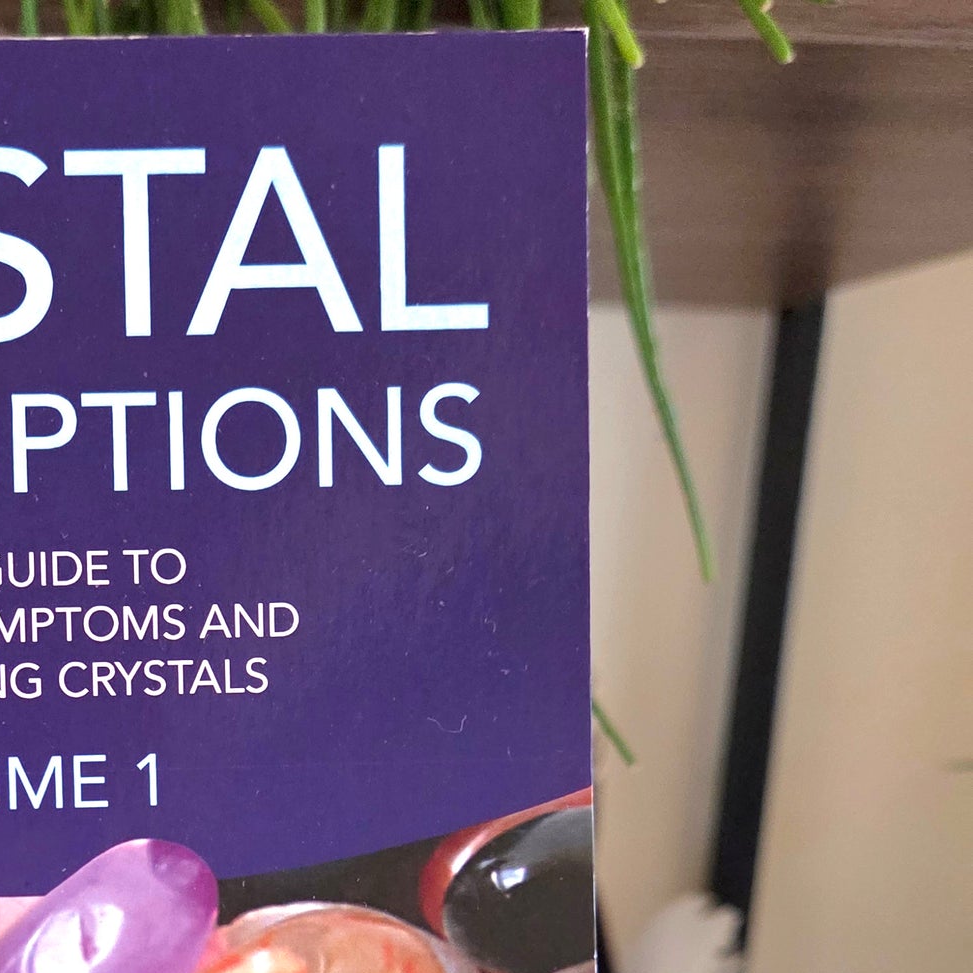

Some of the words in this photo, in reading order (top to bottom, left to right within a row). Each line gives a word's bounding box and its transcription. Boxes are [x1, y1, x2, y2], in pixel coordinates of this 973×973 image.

[122, 547, 187, 585] TO
[199, 602, 300, 639] AND
[58, 657, 269, 698] CRYSTALS
[136, 752, 158, 807] 1
